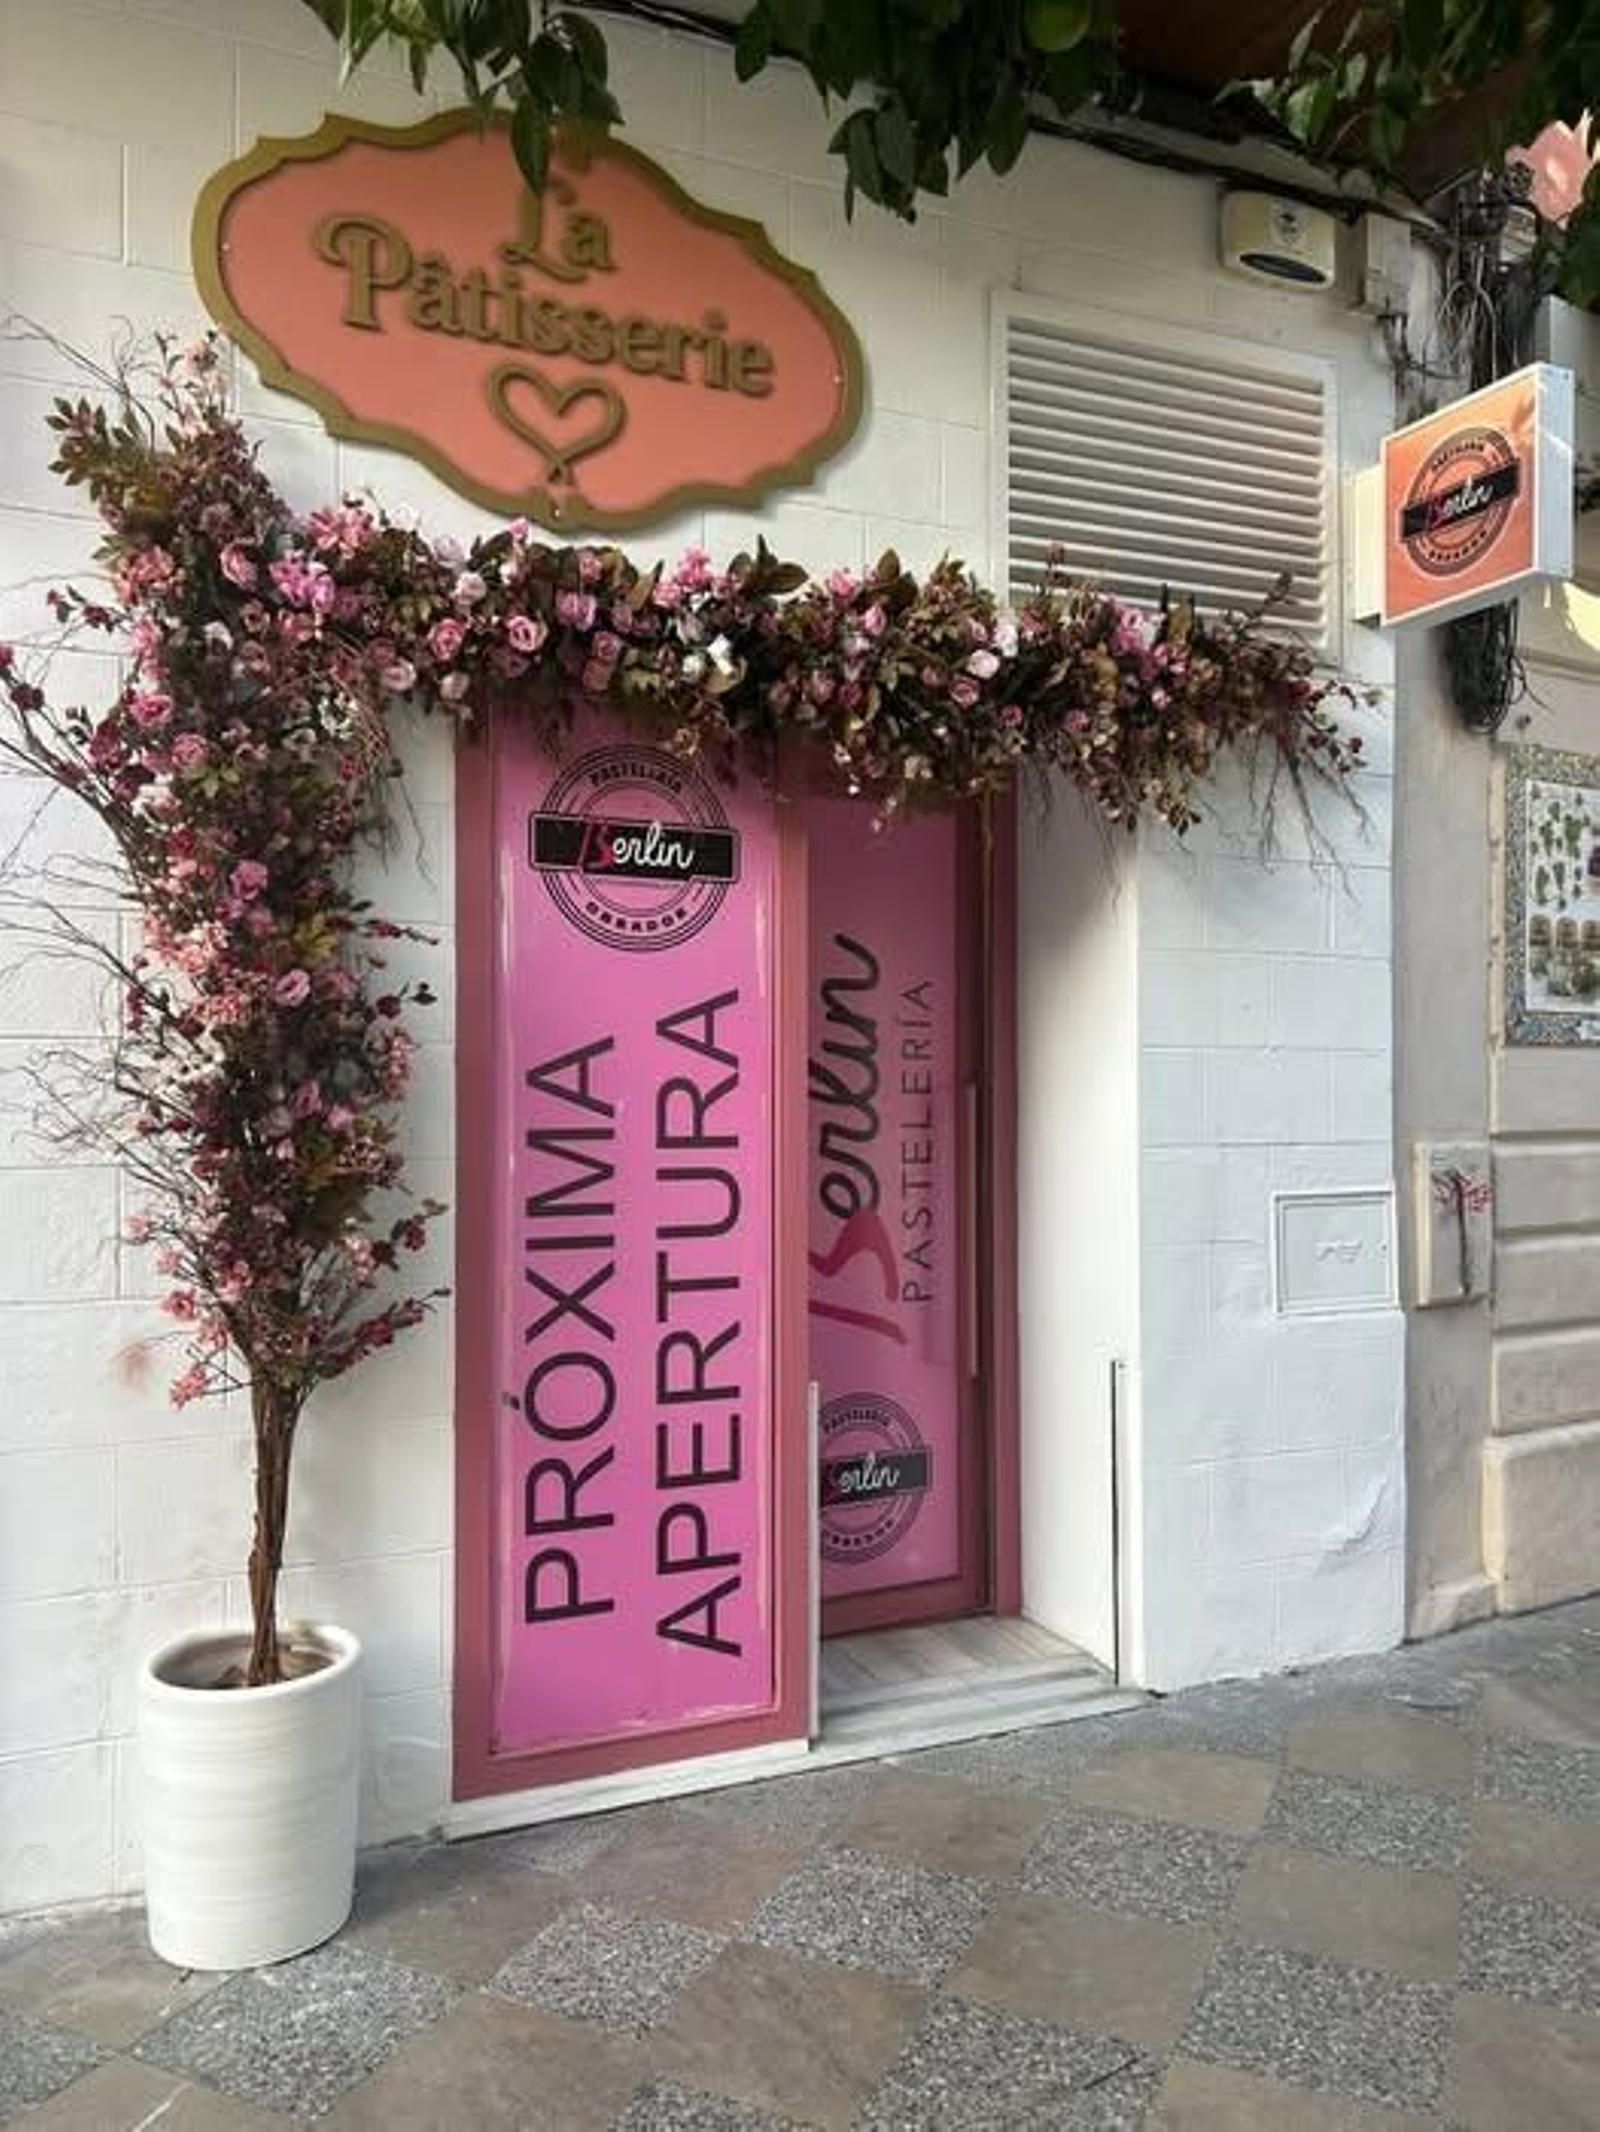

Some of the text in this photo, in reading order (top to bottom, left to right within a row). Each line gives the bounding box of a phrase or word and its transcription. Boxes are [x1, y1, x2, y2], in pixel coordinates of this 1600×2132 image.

[312, 211, 776, 398] Pâtisserie
[499, 175, 618, 284] La
[580, 819, 695, 871] Berlin
[501, 1035, 616, 1624] PRÓXIMA
[655, 988, 742, 1657] APERTURA
